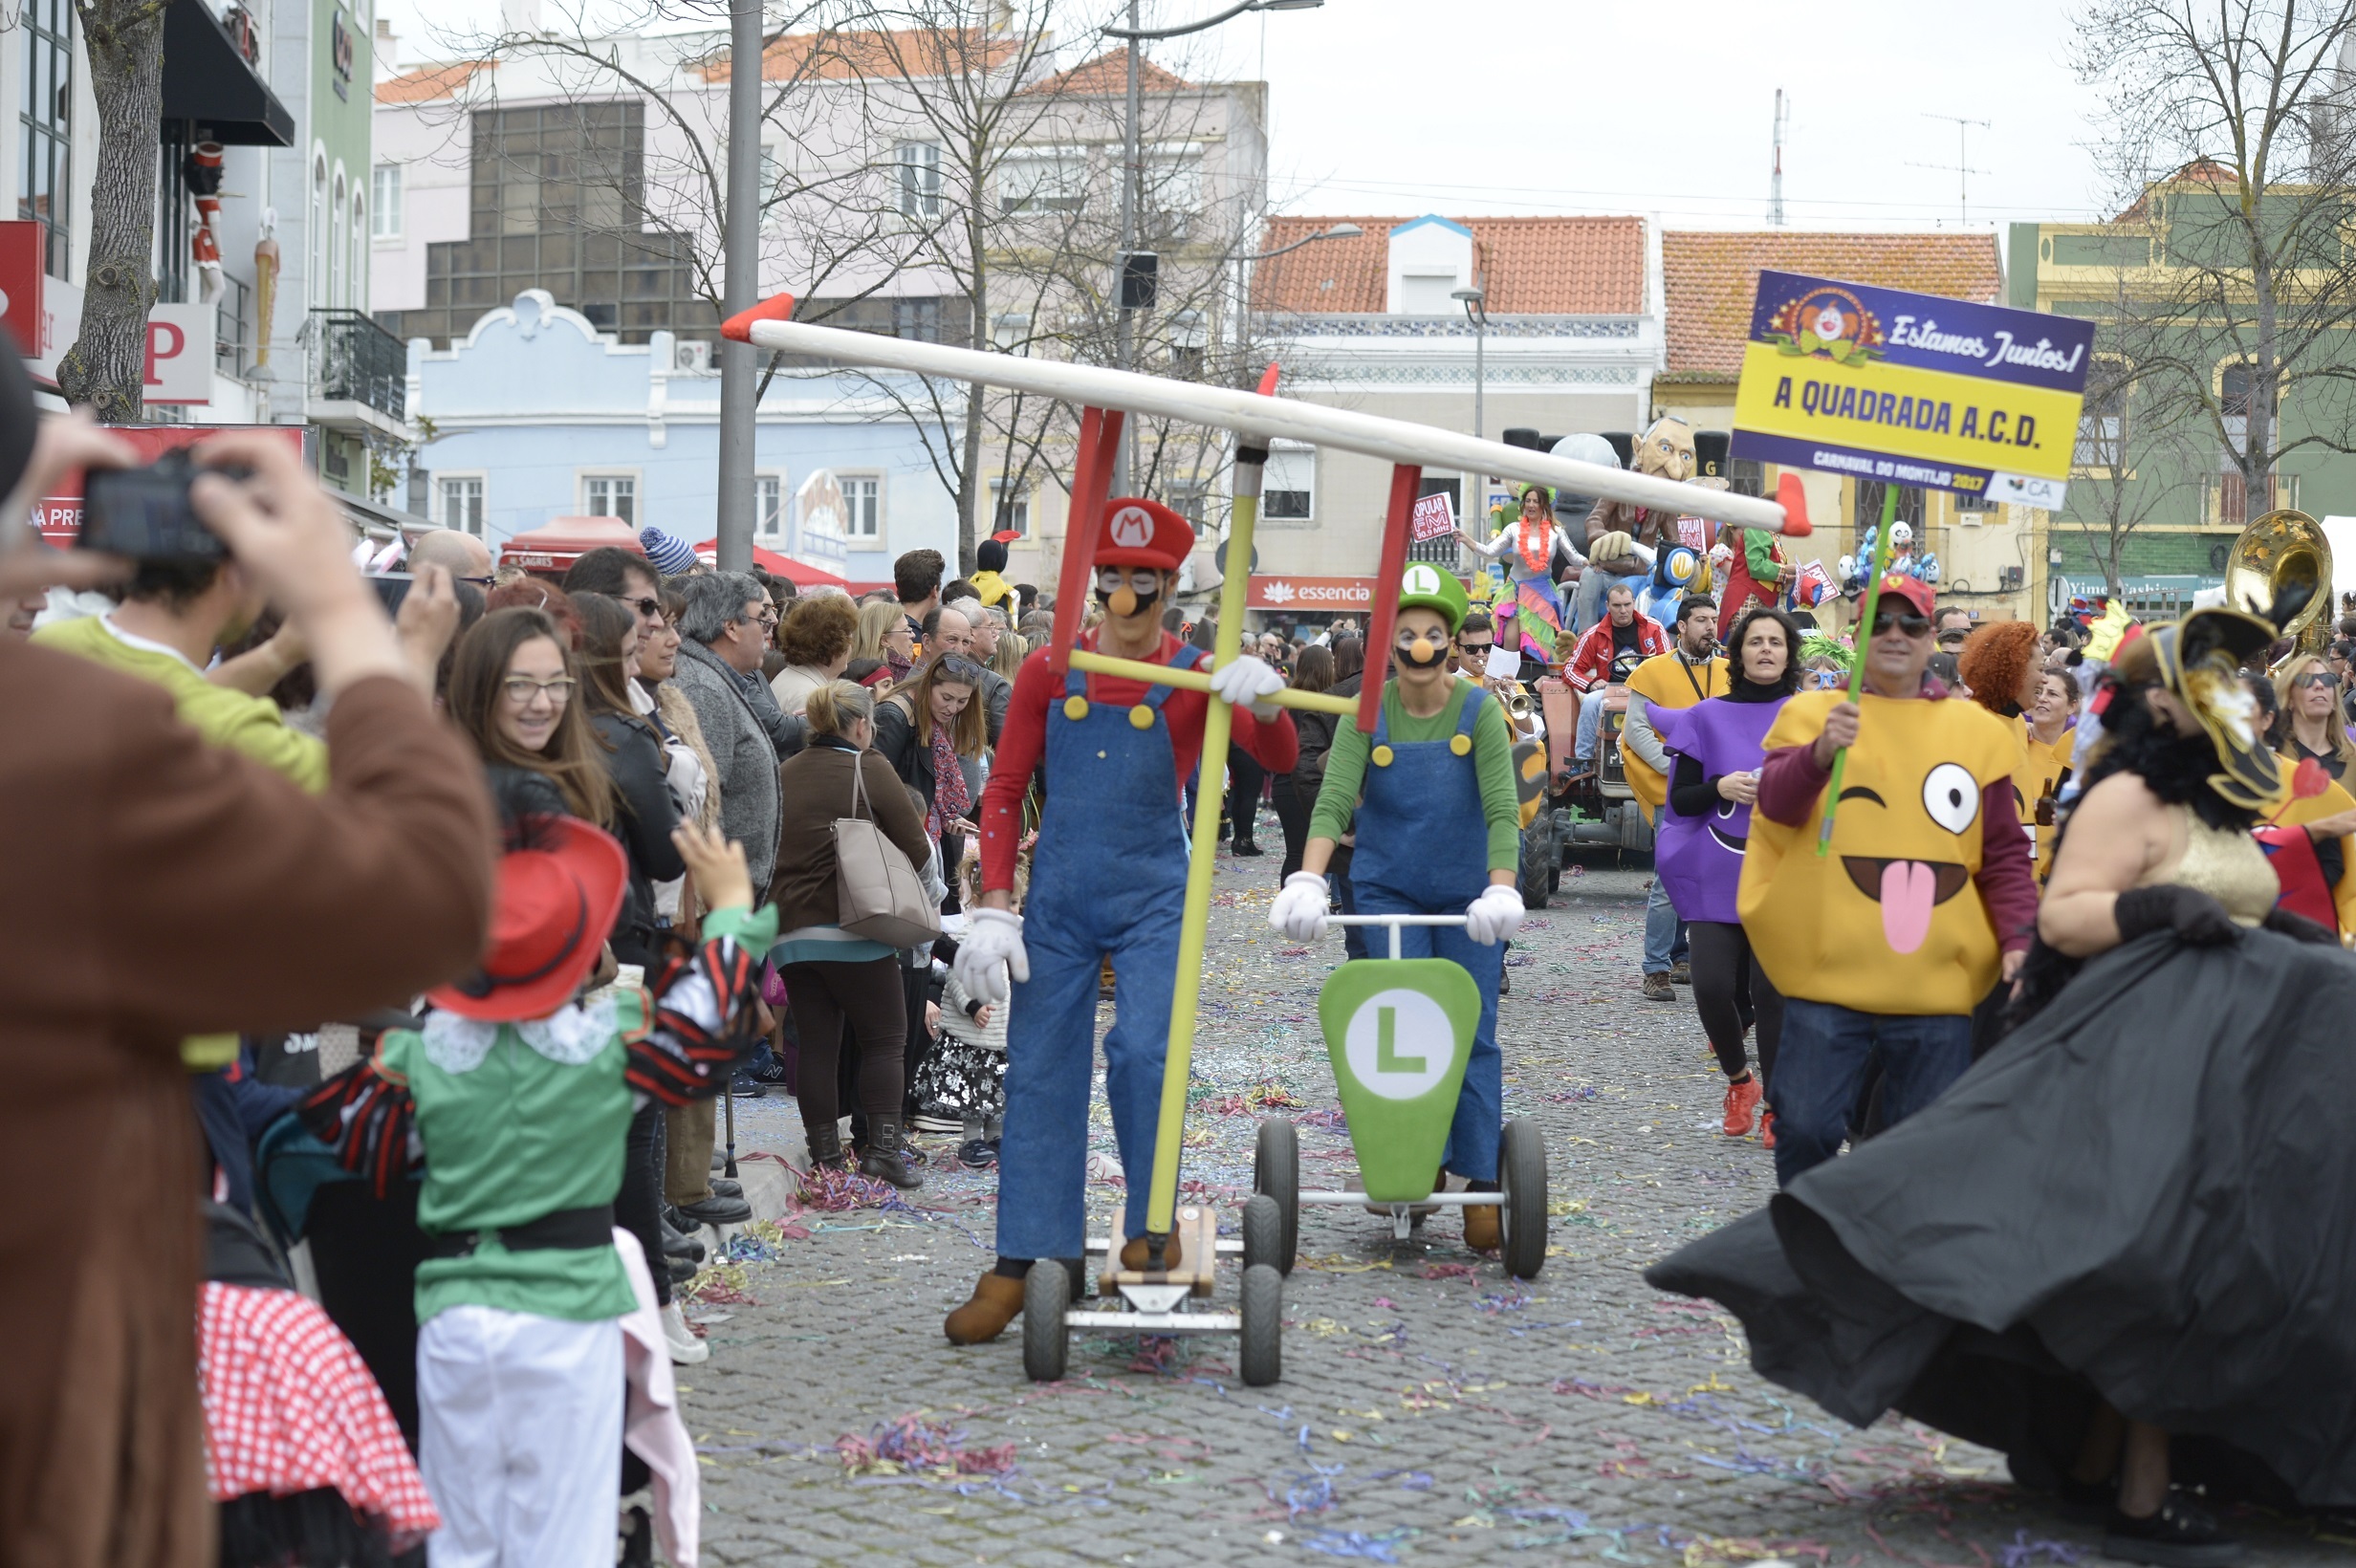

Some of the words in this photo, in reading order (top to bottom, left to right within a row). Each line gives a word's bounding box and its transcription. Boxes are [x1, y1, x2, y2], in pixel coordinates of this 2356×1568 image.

[1888, 315, 1989, 359] Estamos
[1984, 332, 2084, 373] Juntos!
[1773, 376, 1791, 408] A
[1801, 380, 1952, 434] QUADRADA
[1959, 405, 2041, 449] A.C.D.
[1705, 460, 1717, 476] G
[1812, 450, 1874, 474] CARNAVAL
[1875, 460, 1895, 477] DO
[1894, 464, 1952, 487] MONTIJO
[1952, 472, 1986, 491] 2017
[2028, 481, 2052, 497] CA
[1415, 496, 1445, 518] OPULAR
[1116, 512, 1147, 541] M
[1413, 512, 1449, 533] FM
[1417, 529, 1432, 540] 90.9
[1433, 524, 1451, 534] MHz
[1677, 518, 1701, 534] POPULAR
[519, 556, 554, 568] SAGRES
[1298, 581, 1371, 601] essencia
[1414, 570, 1431, 593] L
[1377, 1007, 1427, 1074] L
[763, 1064, 783, 1078] N
